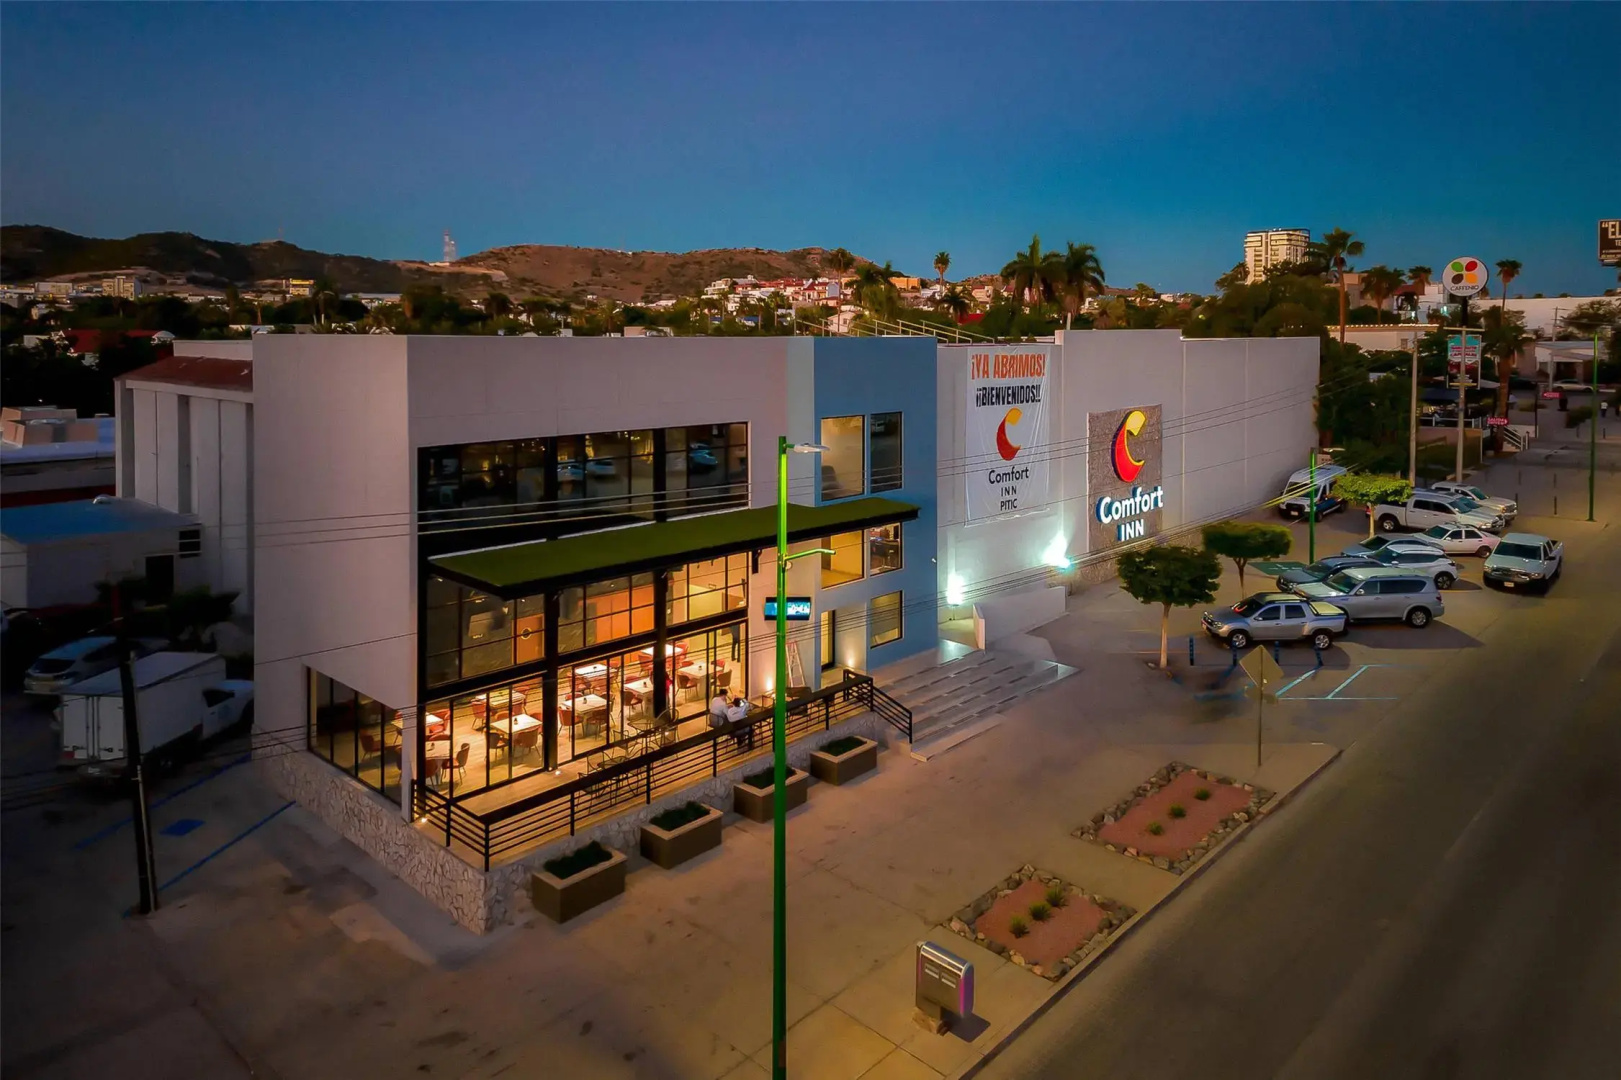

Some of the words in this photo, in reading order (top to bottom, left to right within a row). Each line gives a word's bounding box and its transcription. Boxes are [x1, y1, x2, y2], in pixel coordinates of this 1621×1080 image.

[971, 354, 989, 380] ¡YA
[993, 353, 1046, 379] ABRIMOS!
[976, 384, 1041, 408] ¡¡BIENVENIDOS!!
[988, 466, 1029, 485] Comfort
[1001, 485, 1017, 497] INN
[1000, 498, 1018, 511] PITIC
[1097, 485, 1164, 524] Comfort
[1118, 519, 1145, 542] INN
